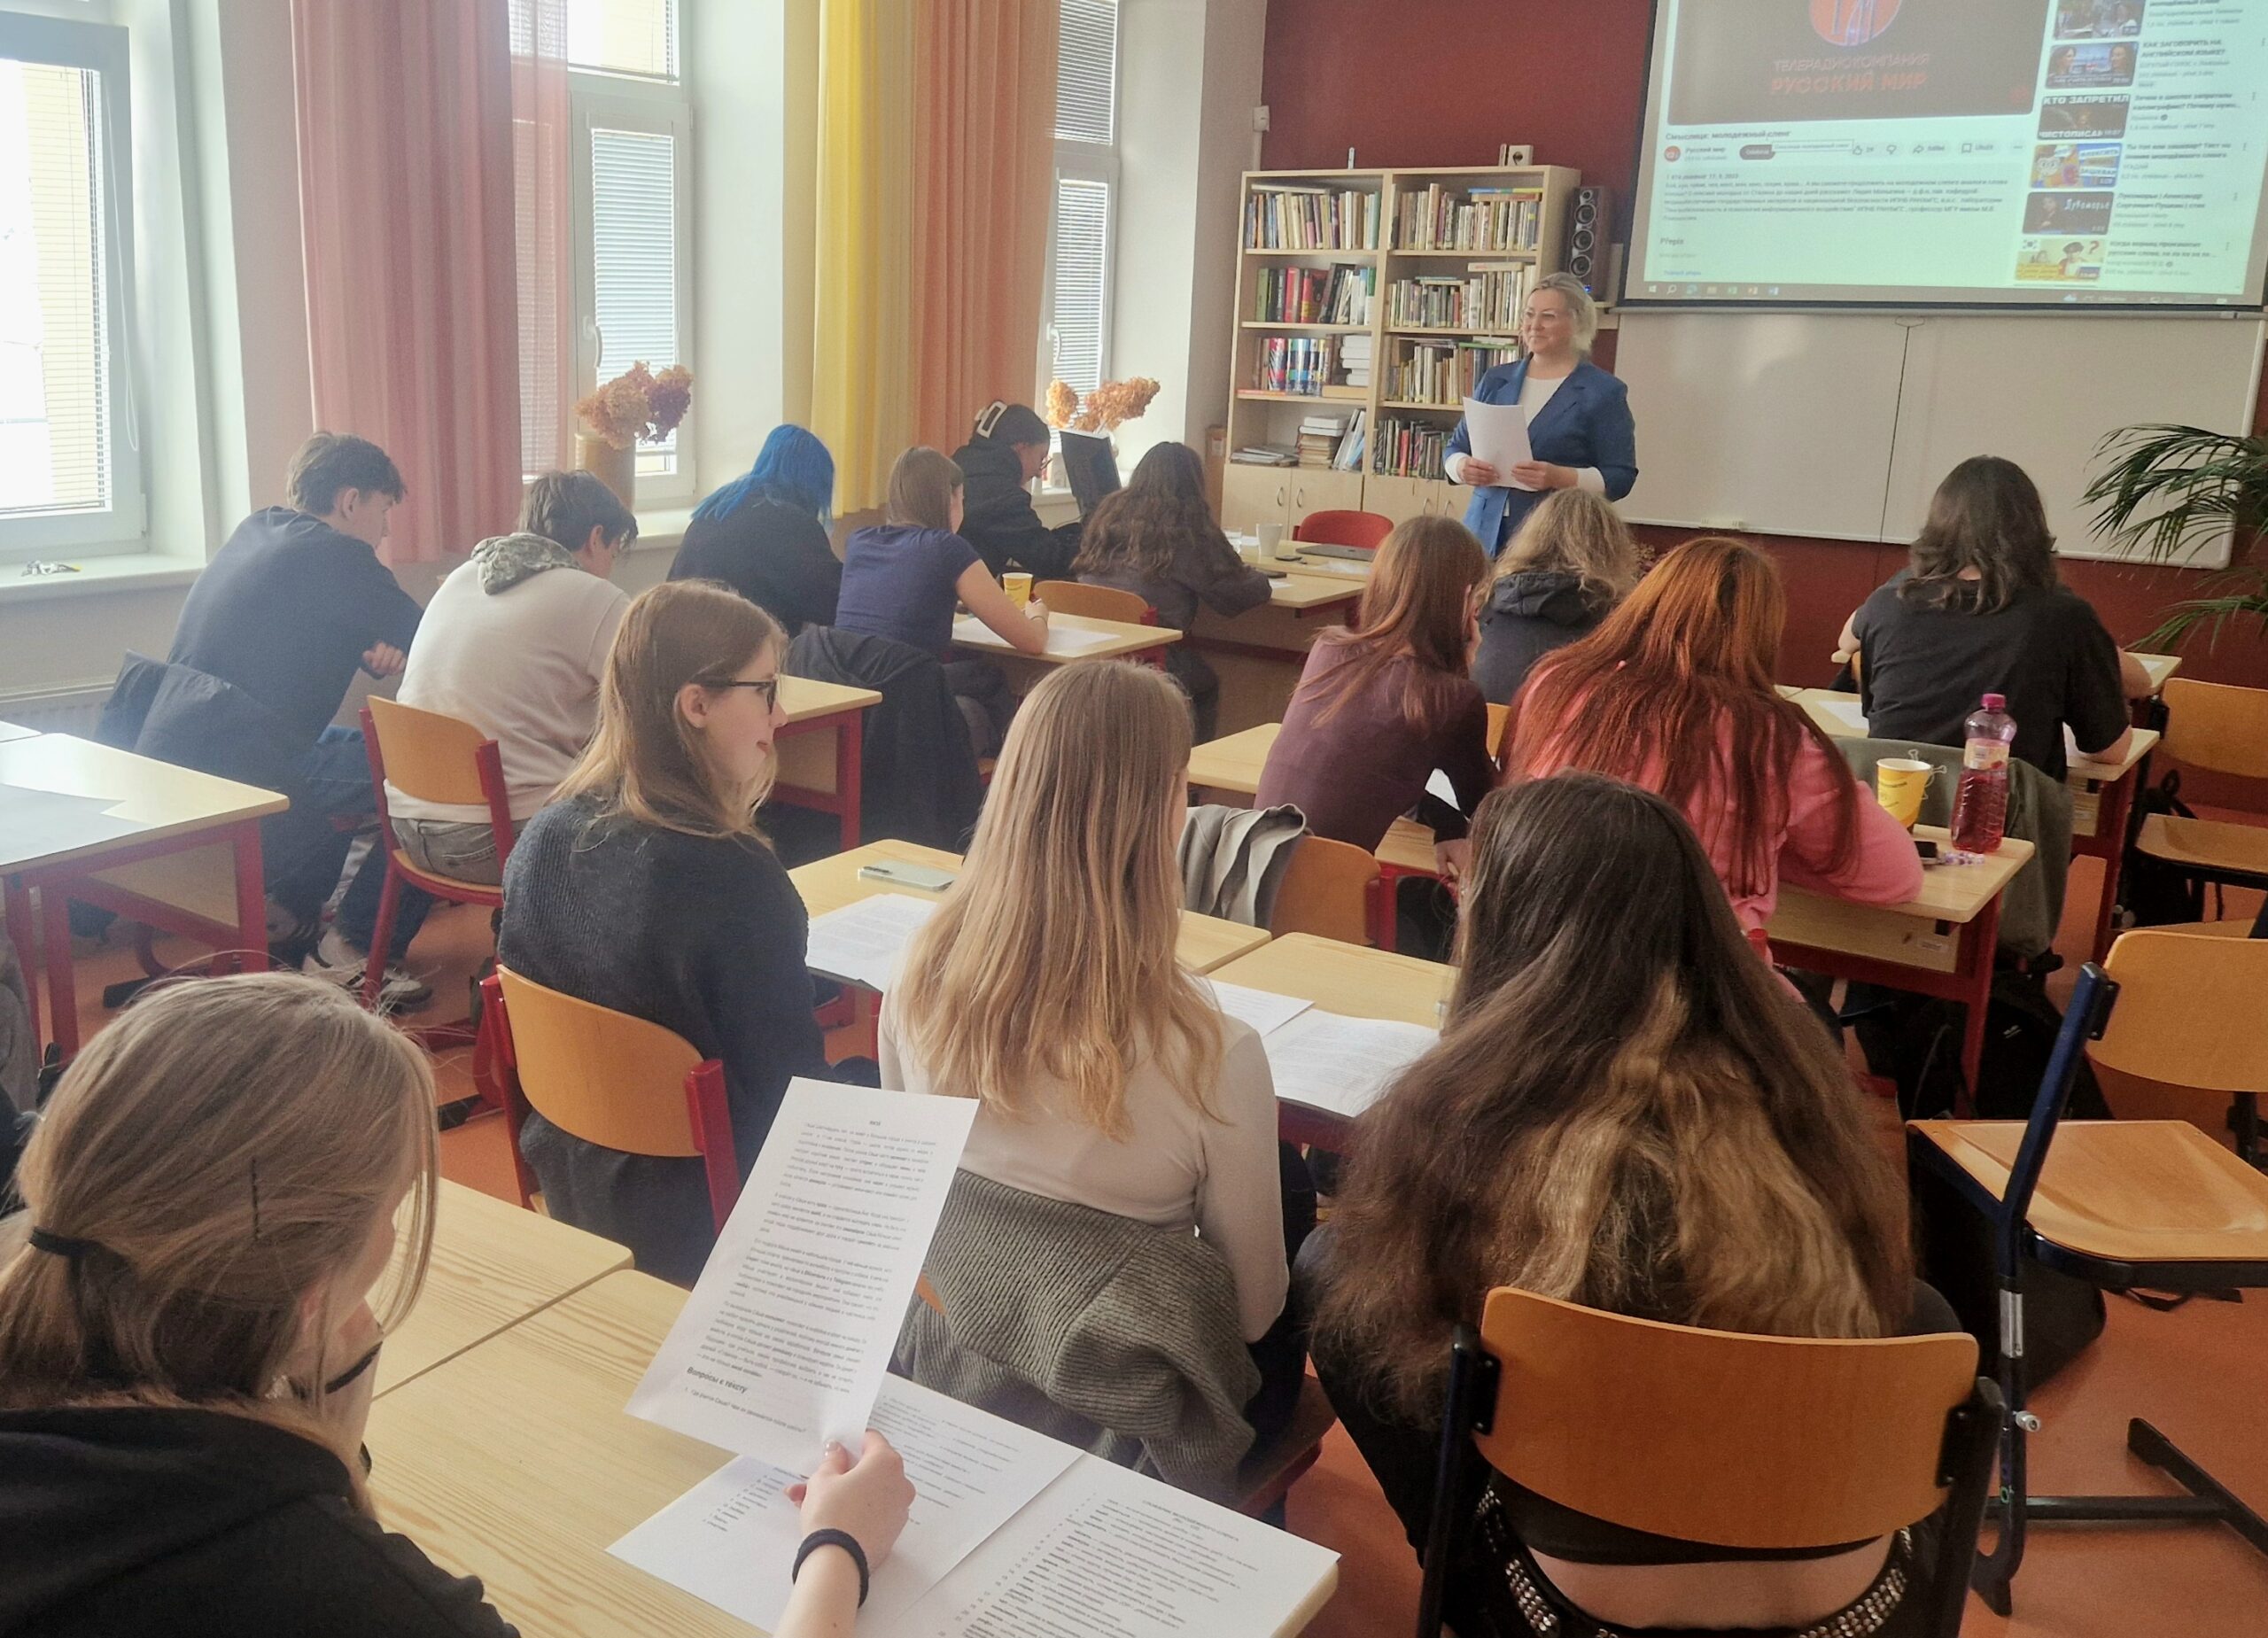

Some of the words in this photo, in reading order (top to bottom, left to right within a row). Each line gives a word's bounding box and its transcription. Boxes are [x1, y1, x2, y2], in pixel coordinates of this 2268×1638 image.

[1775, 53, 1929, 71] ТЕЛЕРАДИОКОМПАНИЯ
[1771, 70, 1874, 94] РУССКИЙ
[1882, 72, 1929, 89] МИР
[2069, 95, 2129, 104] ЗАПРЕТИЛ
